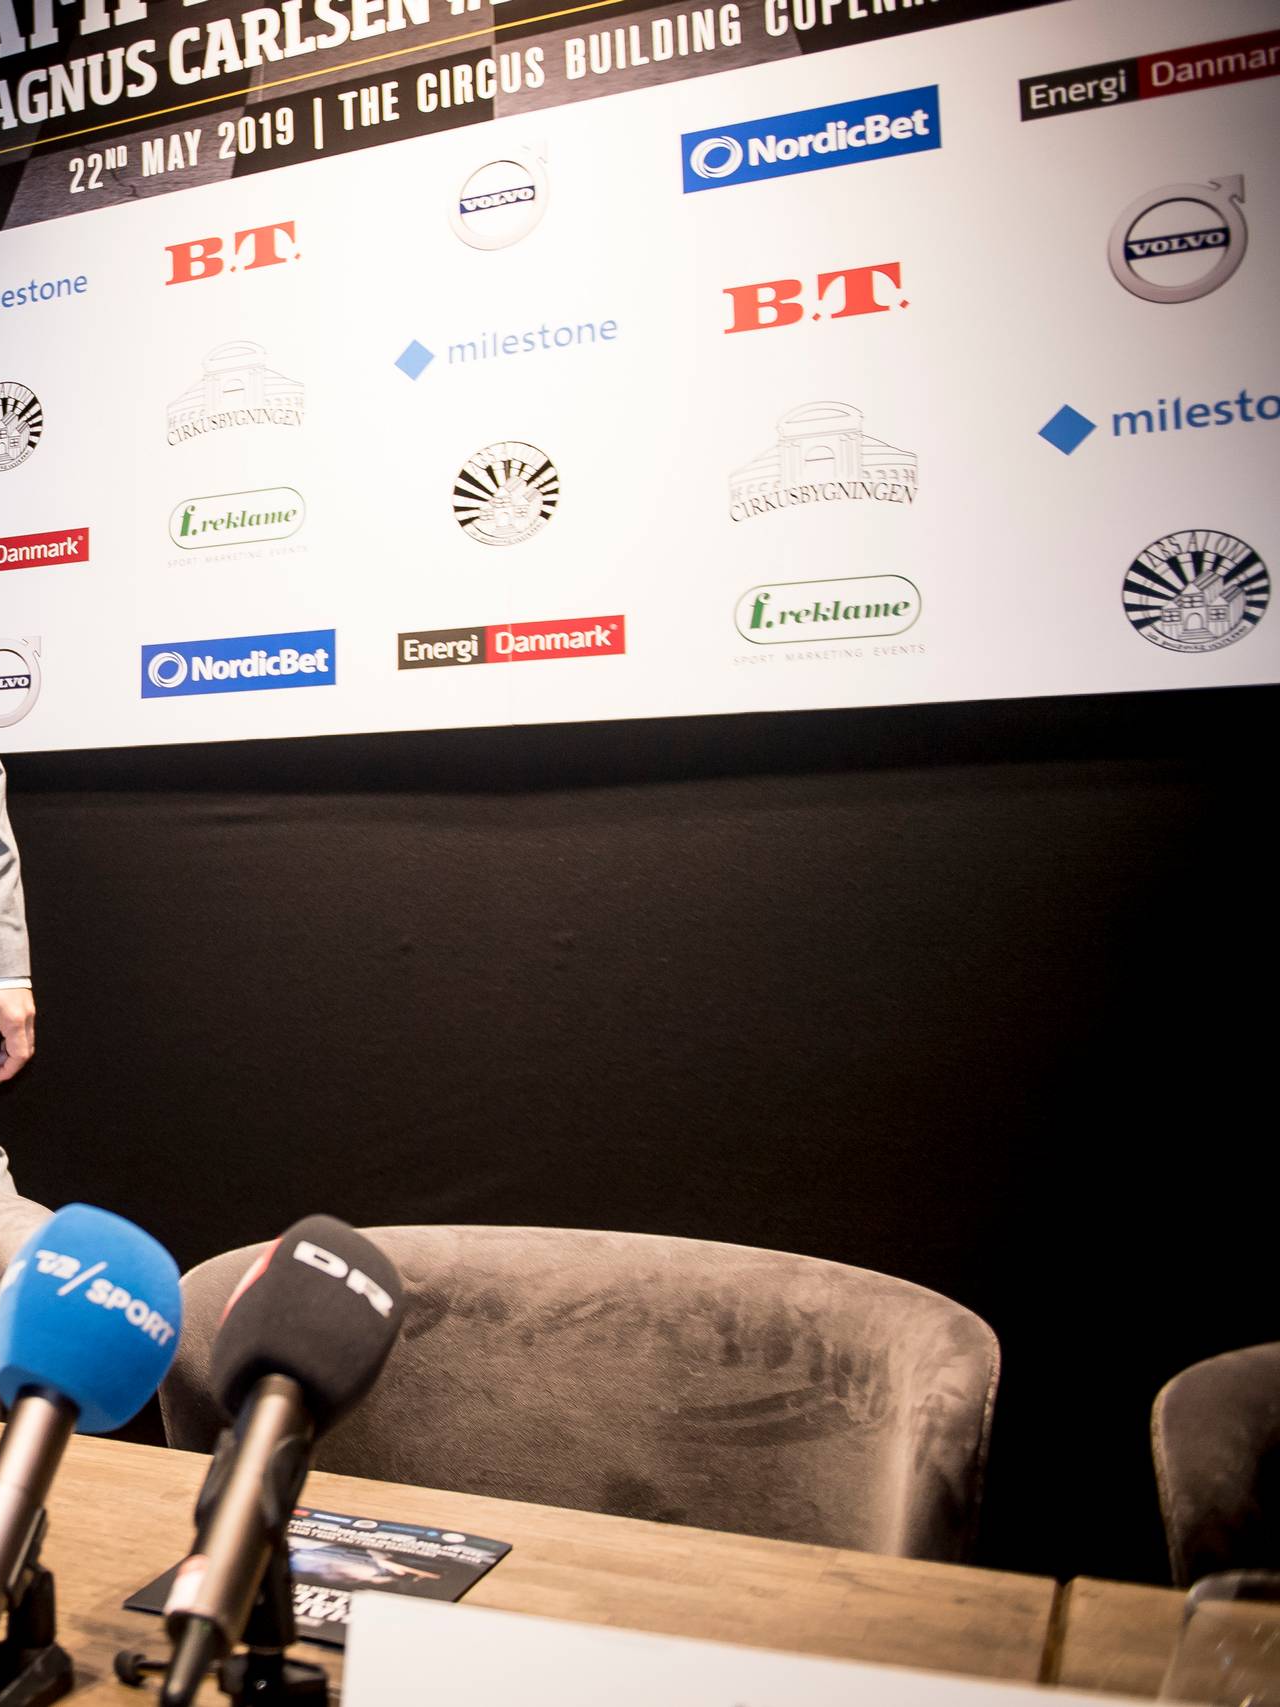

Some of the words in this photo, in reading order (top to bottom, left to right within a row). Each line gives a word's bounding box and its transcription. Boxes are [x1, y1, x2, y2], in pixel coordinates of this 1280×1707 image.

[69, 145, 128, 194] 22ND
[143, 129, 202, 177] MAY
[218, 108, 294, 160] 2019
[338, 81, 400, 131] THE
[416, 46, 545, 114] CIRCUS
[565, 3, 742, 80] BUILDING
[1030, 70, 1127, 110] Energi
[748, 109, 930, 167] NordicBet
[461, 187, 534, 212] VOLVO
[165, 220, 301, 286] B.T.
[1128, 231, 1226, 256] VOLVO
[723, 262, 910, 334] B.T.
[448, 318, 618, 365] milestone
[167, 407, 306, 447] CIRKUSBYGNINGEN
[180, 505, 298, 537] f.reklame
[729, 481, 919, 523] CIRKUSBYGNINGEN
[750, 592, 911, 630] f.reklame
[403, 635, 479, 663] Energi
[495, 625, 612, 656] Danmark
[192, 648, 329, 683] NordicBet
[293, 1240, 393, 1318] DR
